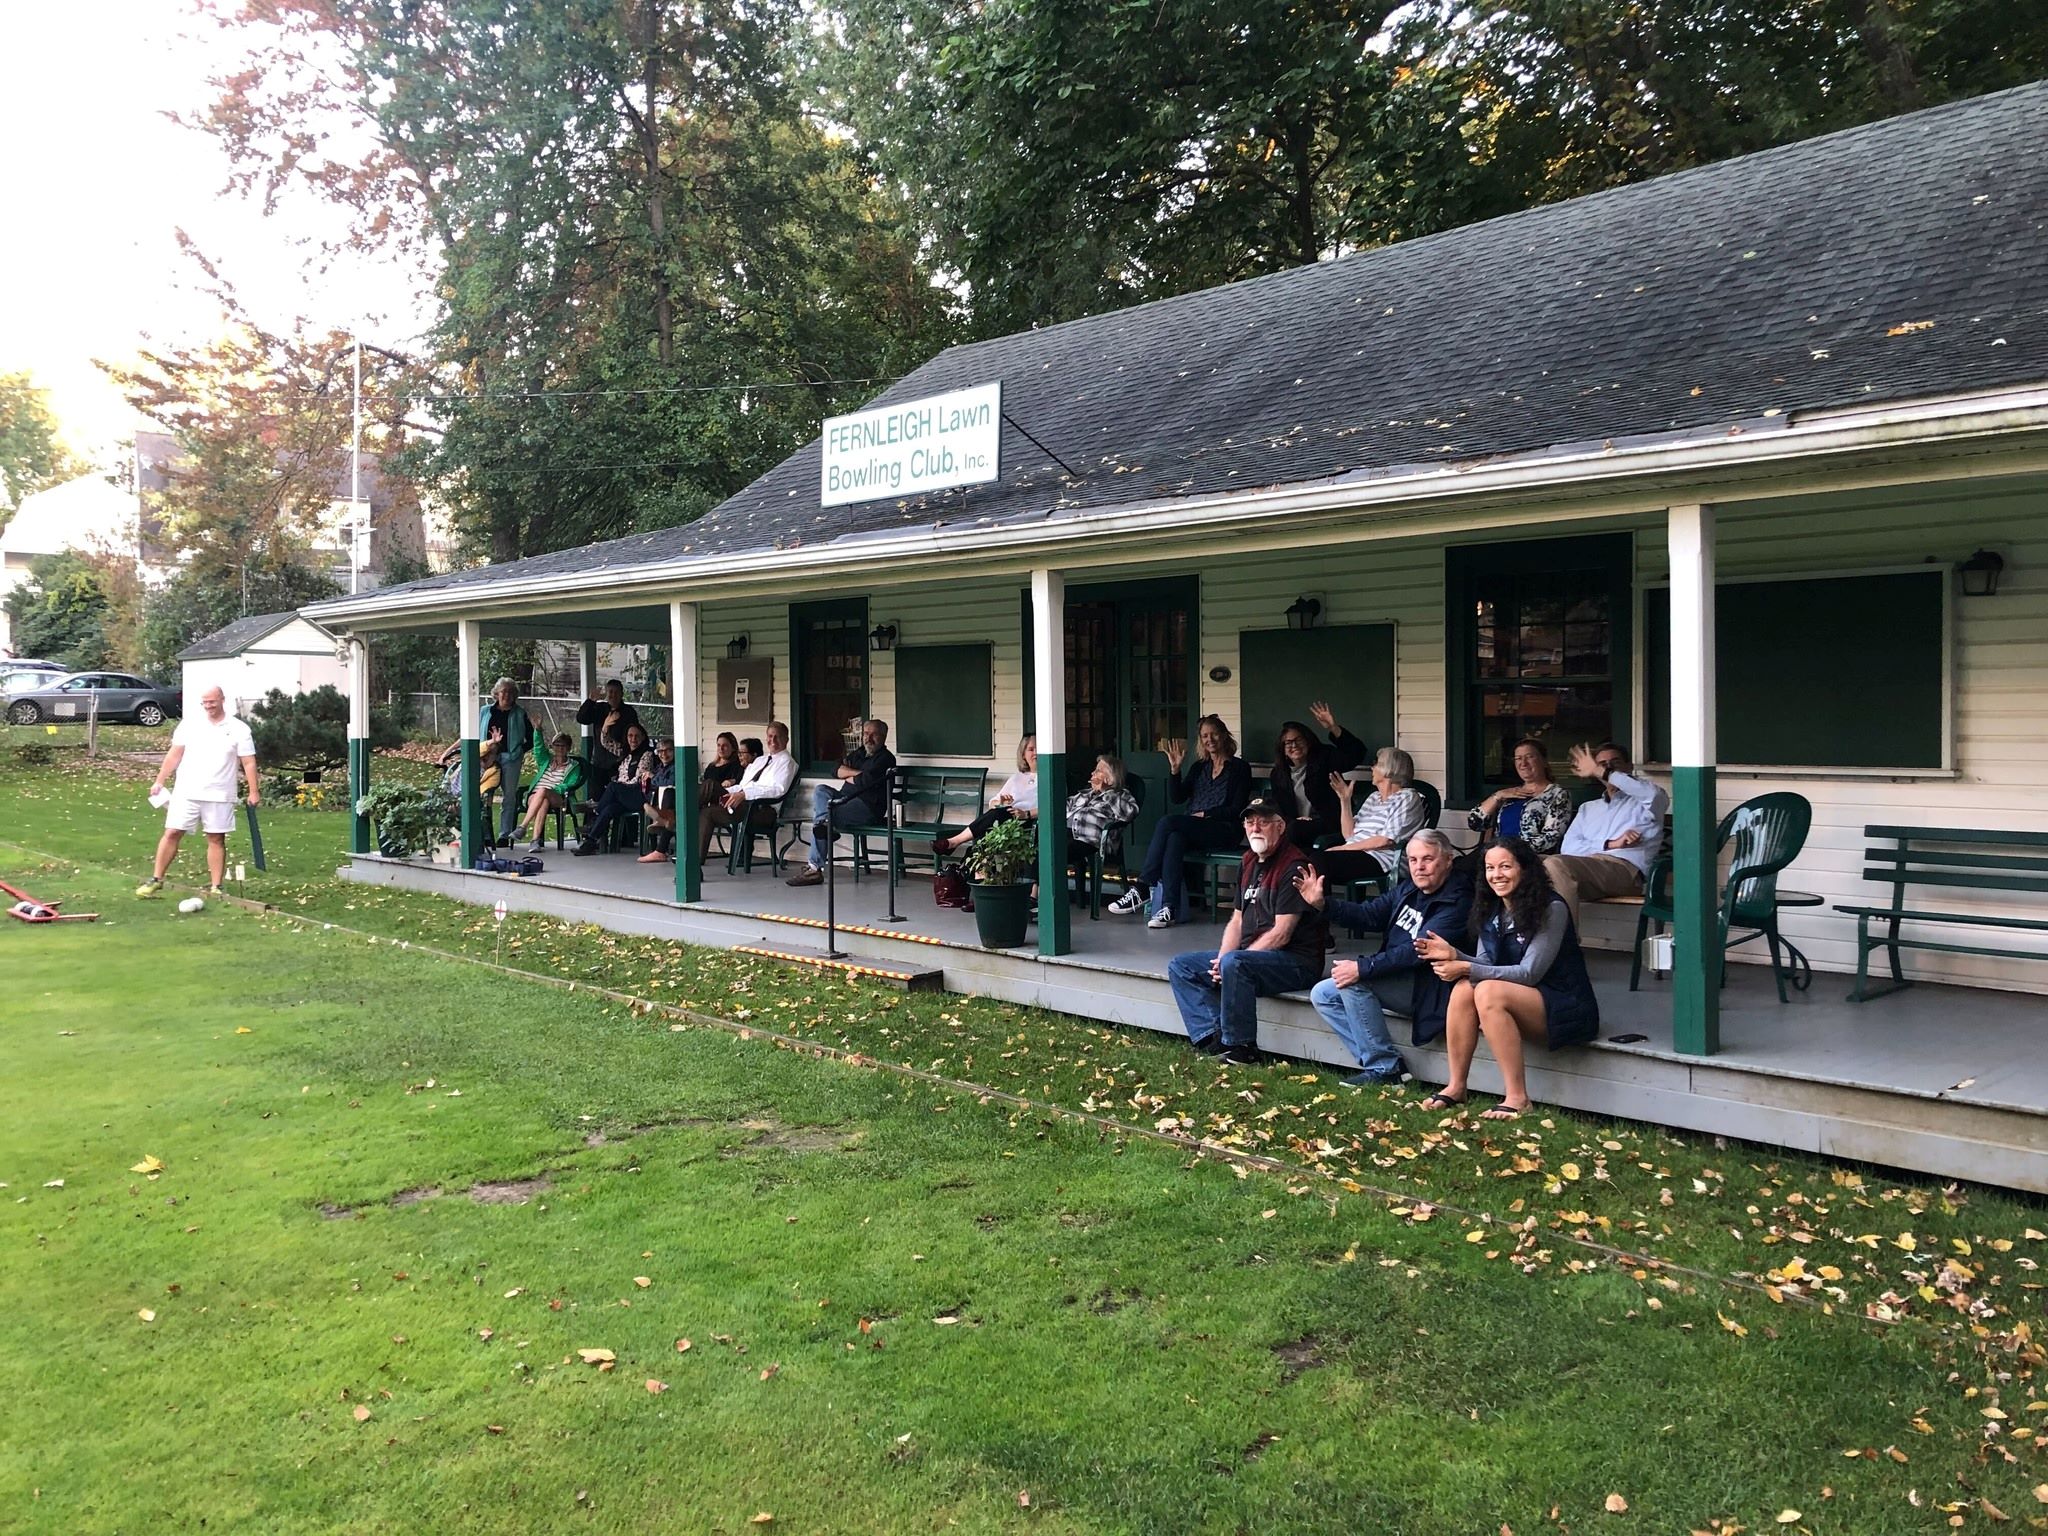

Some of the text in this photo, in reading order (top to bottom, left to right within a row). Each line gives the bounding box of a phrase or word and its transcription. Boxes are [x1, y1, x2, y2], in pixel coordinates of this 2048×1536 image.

[829, 403, 990, 455] FERNLEIGH Lawn
[828, 445, 989, 491] Bowling Club, Inc.
